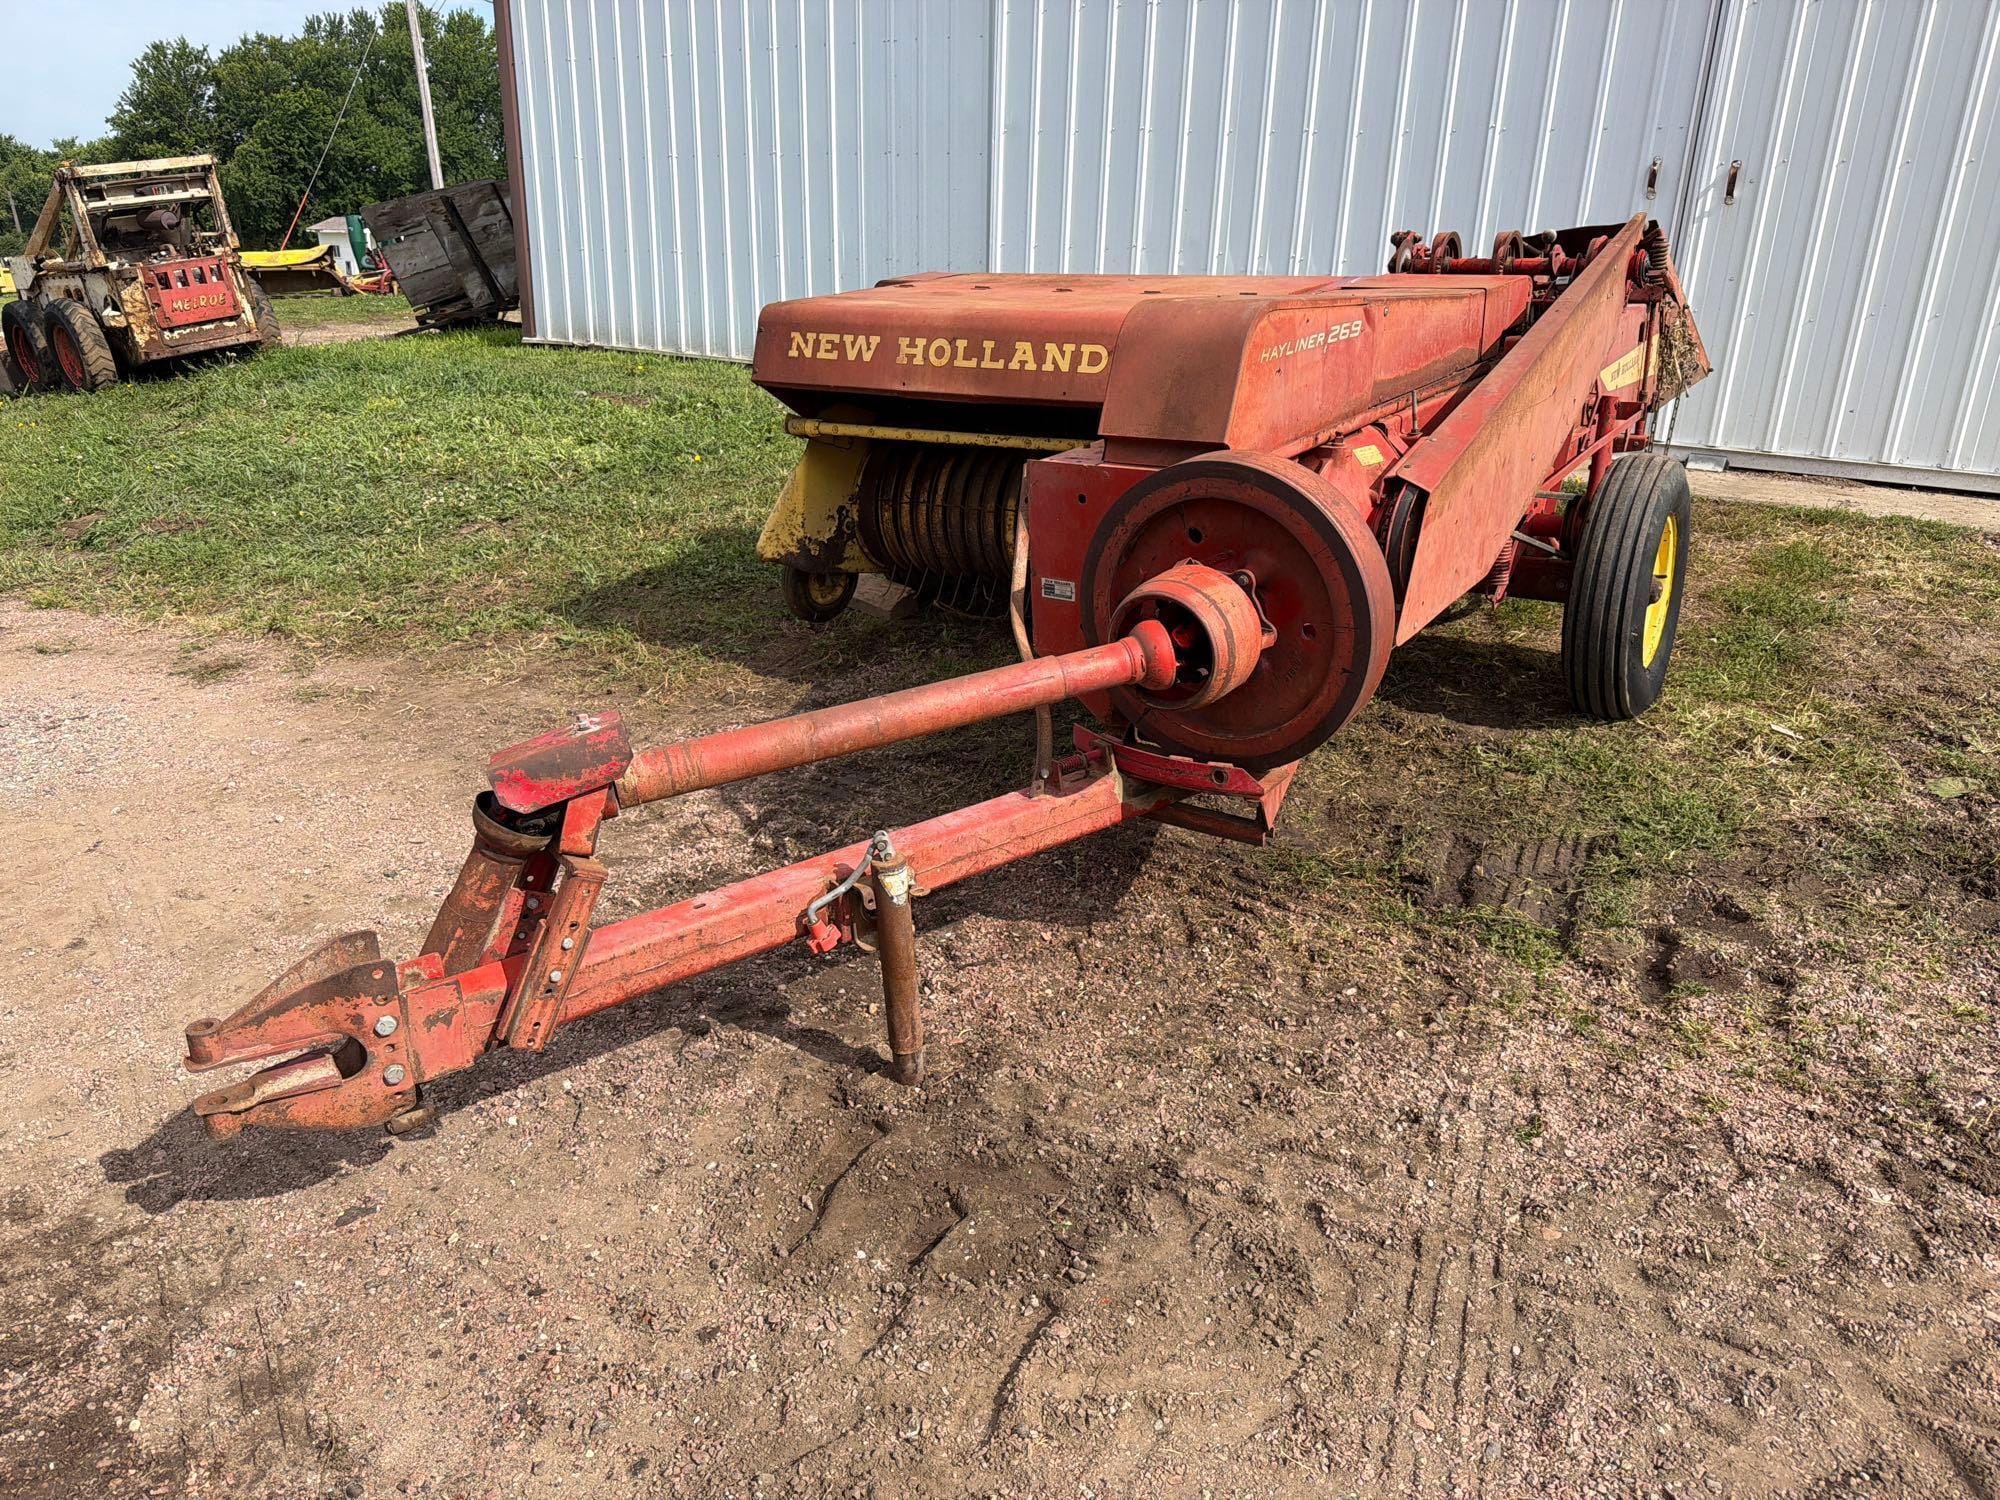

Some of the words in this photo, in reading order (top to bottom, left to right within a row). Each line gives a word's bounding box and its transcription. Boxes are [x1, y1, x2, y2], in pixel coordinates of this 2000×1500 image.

[171, 293, 226, 313] MELROE
[788, 331, 881, 362] NEW
[896, 336, 1110, 374] HOLLAND
[1261, 332, 1325, 363] HAYLINER
[1327, 320, 1363, 343] 269
